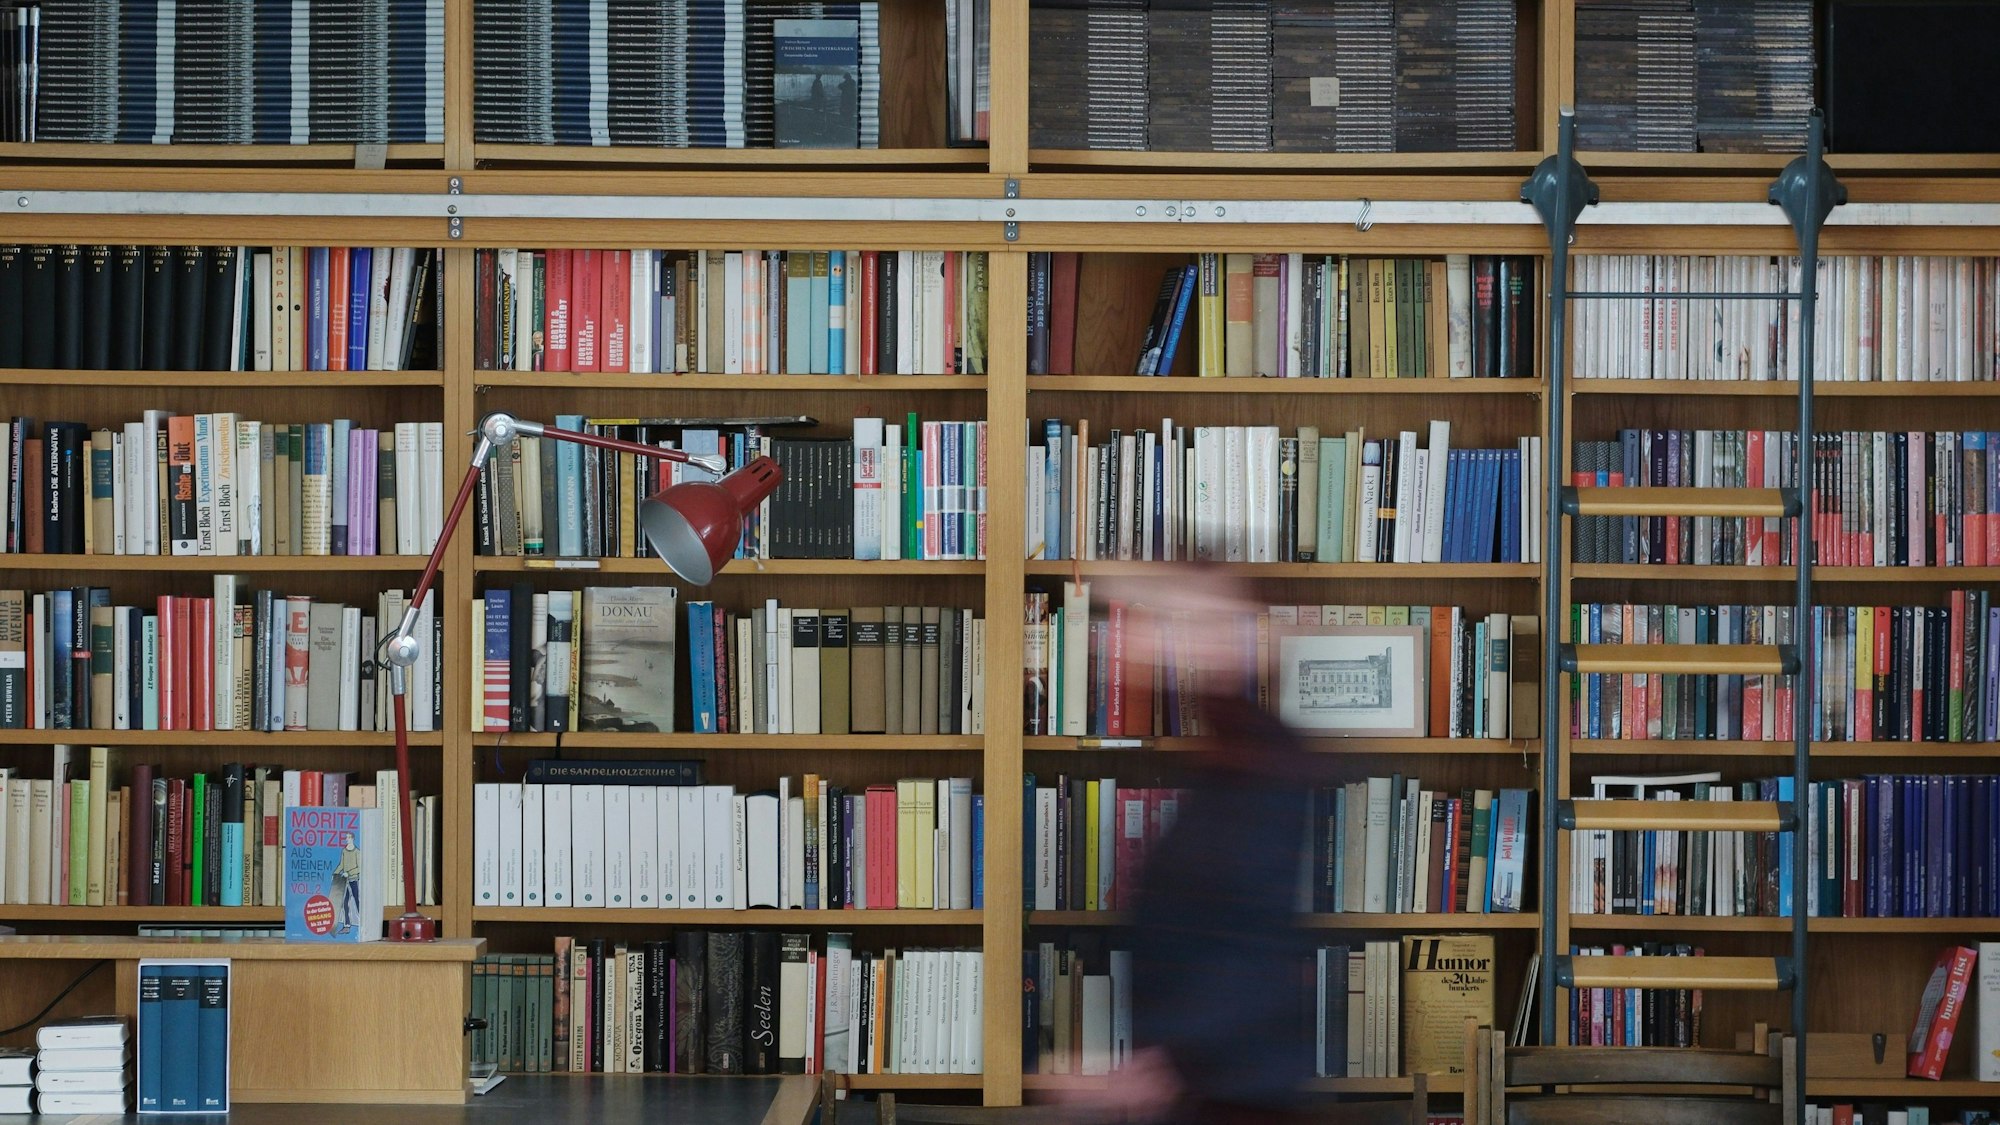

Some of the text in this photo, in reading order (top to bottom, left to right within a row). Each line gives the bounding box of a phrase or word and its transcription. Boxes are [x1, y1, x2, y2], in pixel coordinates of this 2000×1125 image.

[1036, 272, 1044, 308] FLYNNS
[1386, 286, 1394, 303] EUGEN
[550, 319, 559, 351] HJORTH
[559, 300, 567, 351] ROSENFELDT
[1027, 326, 1034, 338] IM
[578, 337, 586, 367] HJORTH
[586, 321, 594, 367] ROSENFELDT
[609, 340, 617, 368] HJORTH
[616, 324, 624, 368] ROSENFELDT
[51, 428, 59, 476] ALTERNATIVE
[1100, 449, 1108, 465] Japan
[175, 442, 193, 501] Asche und Glut
[196, 417, 212, 551] Ernst Bloch Experimentum Mundi
[218, 416, 231, 533] Ernst Bloch Zwischenwelten
[567, 475, 576, 530] KARLMANN
[1364, 475, 1375, 506] Nackt
[0, 602, 9, 642] BONITA
[11, 601, 22, 644] AVENUE
[76, 601, 84, 649] Nachtschatten
[601, 606, 653, 617] DONAU
[233, 677, 242, 730] Richard Dehmel
[549, 767, 568, 776] DIE
[291, 811, 359, 830] MORITZ
[1327, 817, 1335, 843] Himmeln
[291, 829, 350, 848] GÖTZE
[291, 847, 312, 858] AUS
[291, 860, 333, 871] MEINEM
[1326, 844, 1334, 870] fremden
[291, 871, 325, 882] LEBEN
[315, 885, 322, 895] 2
[628, 954, 636, 974] USA
[1404, 939, 1491, 971] Humor
[1441, 976, 1453, 984] des
[1470, 976, 1489, 984] Jahr-
[1448, 984, 1480, 992] hunderts
[1940, 956, 1968, 1021] bucket list
[633, 954, 644, 1055] Oregon Washington
[750, 985, 774, 1047] Seelen
[576, 1026, 584, 1051] MEHRING
